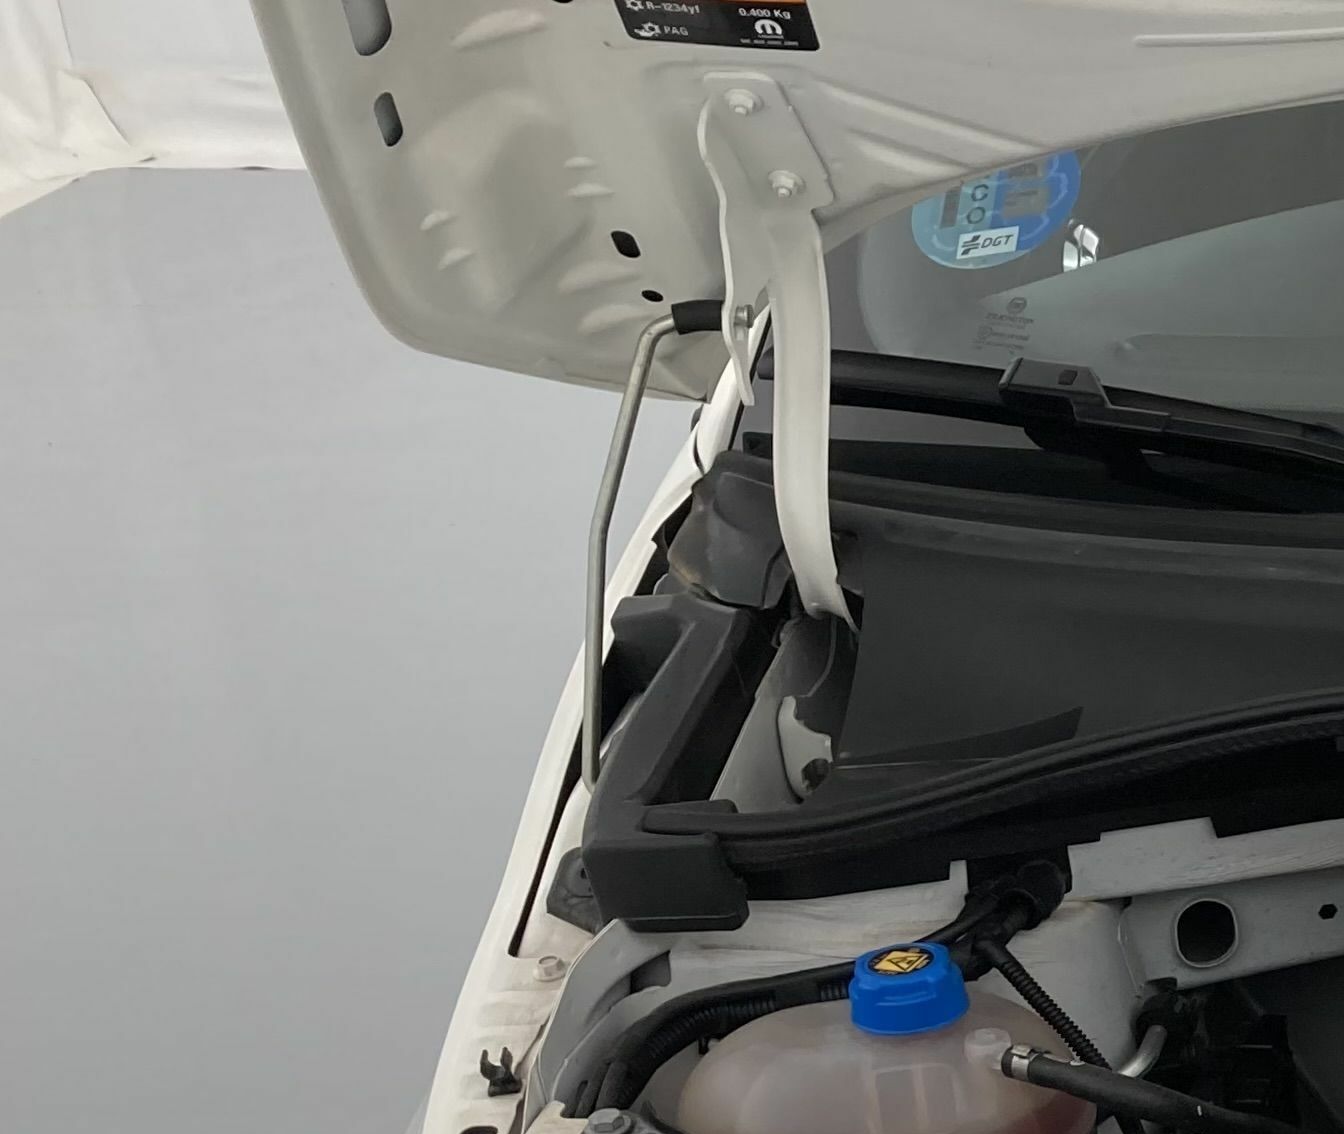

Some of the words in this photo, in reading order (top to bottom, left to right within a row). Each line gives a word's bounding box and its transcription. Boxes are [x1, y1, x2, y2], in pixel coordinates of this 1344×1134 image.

[738, 7, 770, 18] 0.400
[773, 8, 791, 20] Kg
[663, 25, 689, 36] PAG
[980, 233, 1014, 249] DGT
